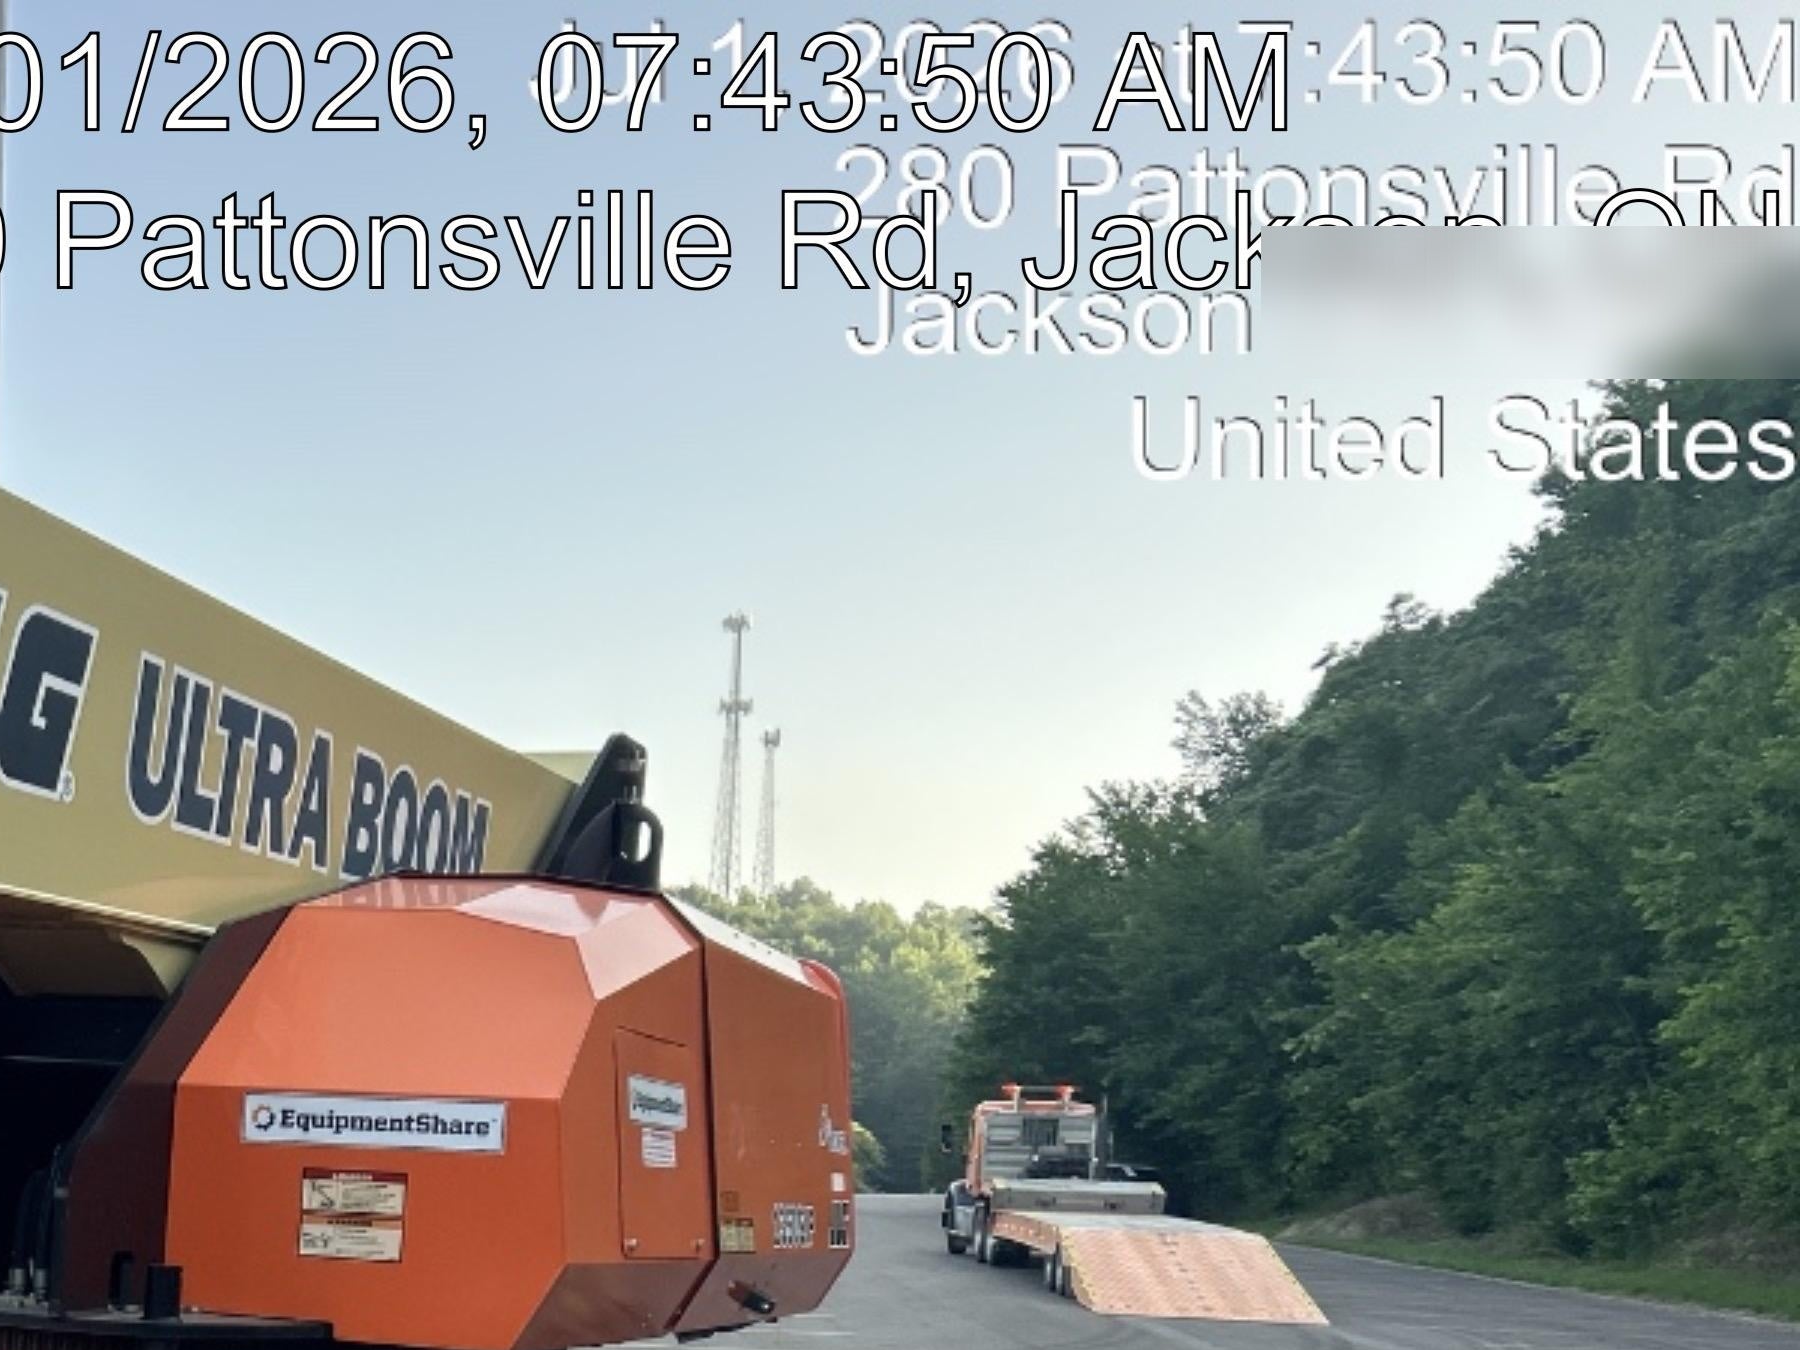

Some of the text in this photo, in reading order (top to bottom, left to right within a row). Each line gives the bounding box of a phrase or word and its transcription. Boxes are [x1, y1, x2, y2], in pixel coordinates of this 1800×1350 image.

[126, 650, 493, 883] ULTRA BOOM
[280, 1108, 492, 1137] EquipmentShare
